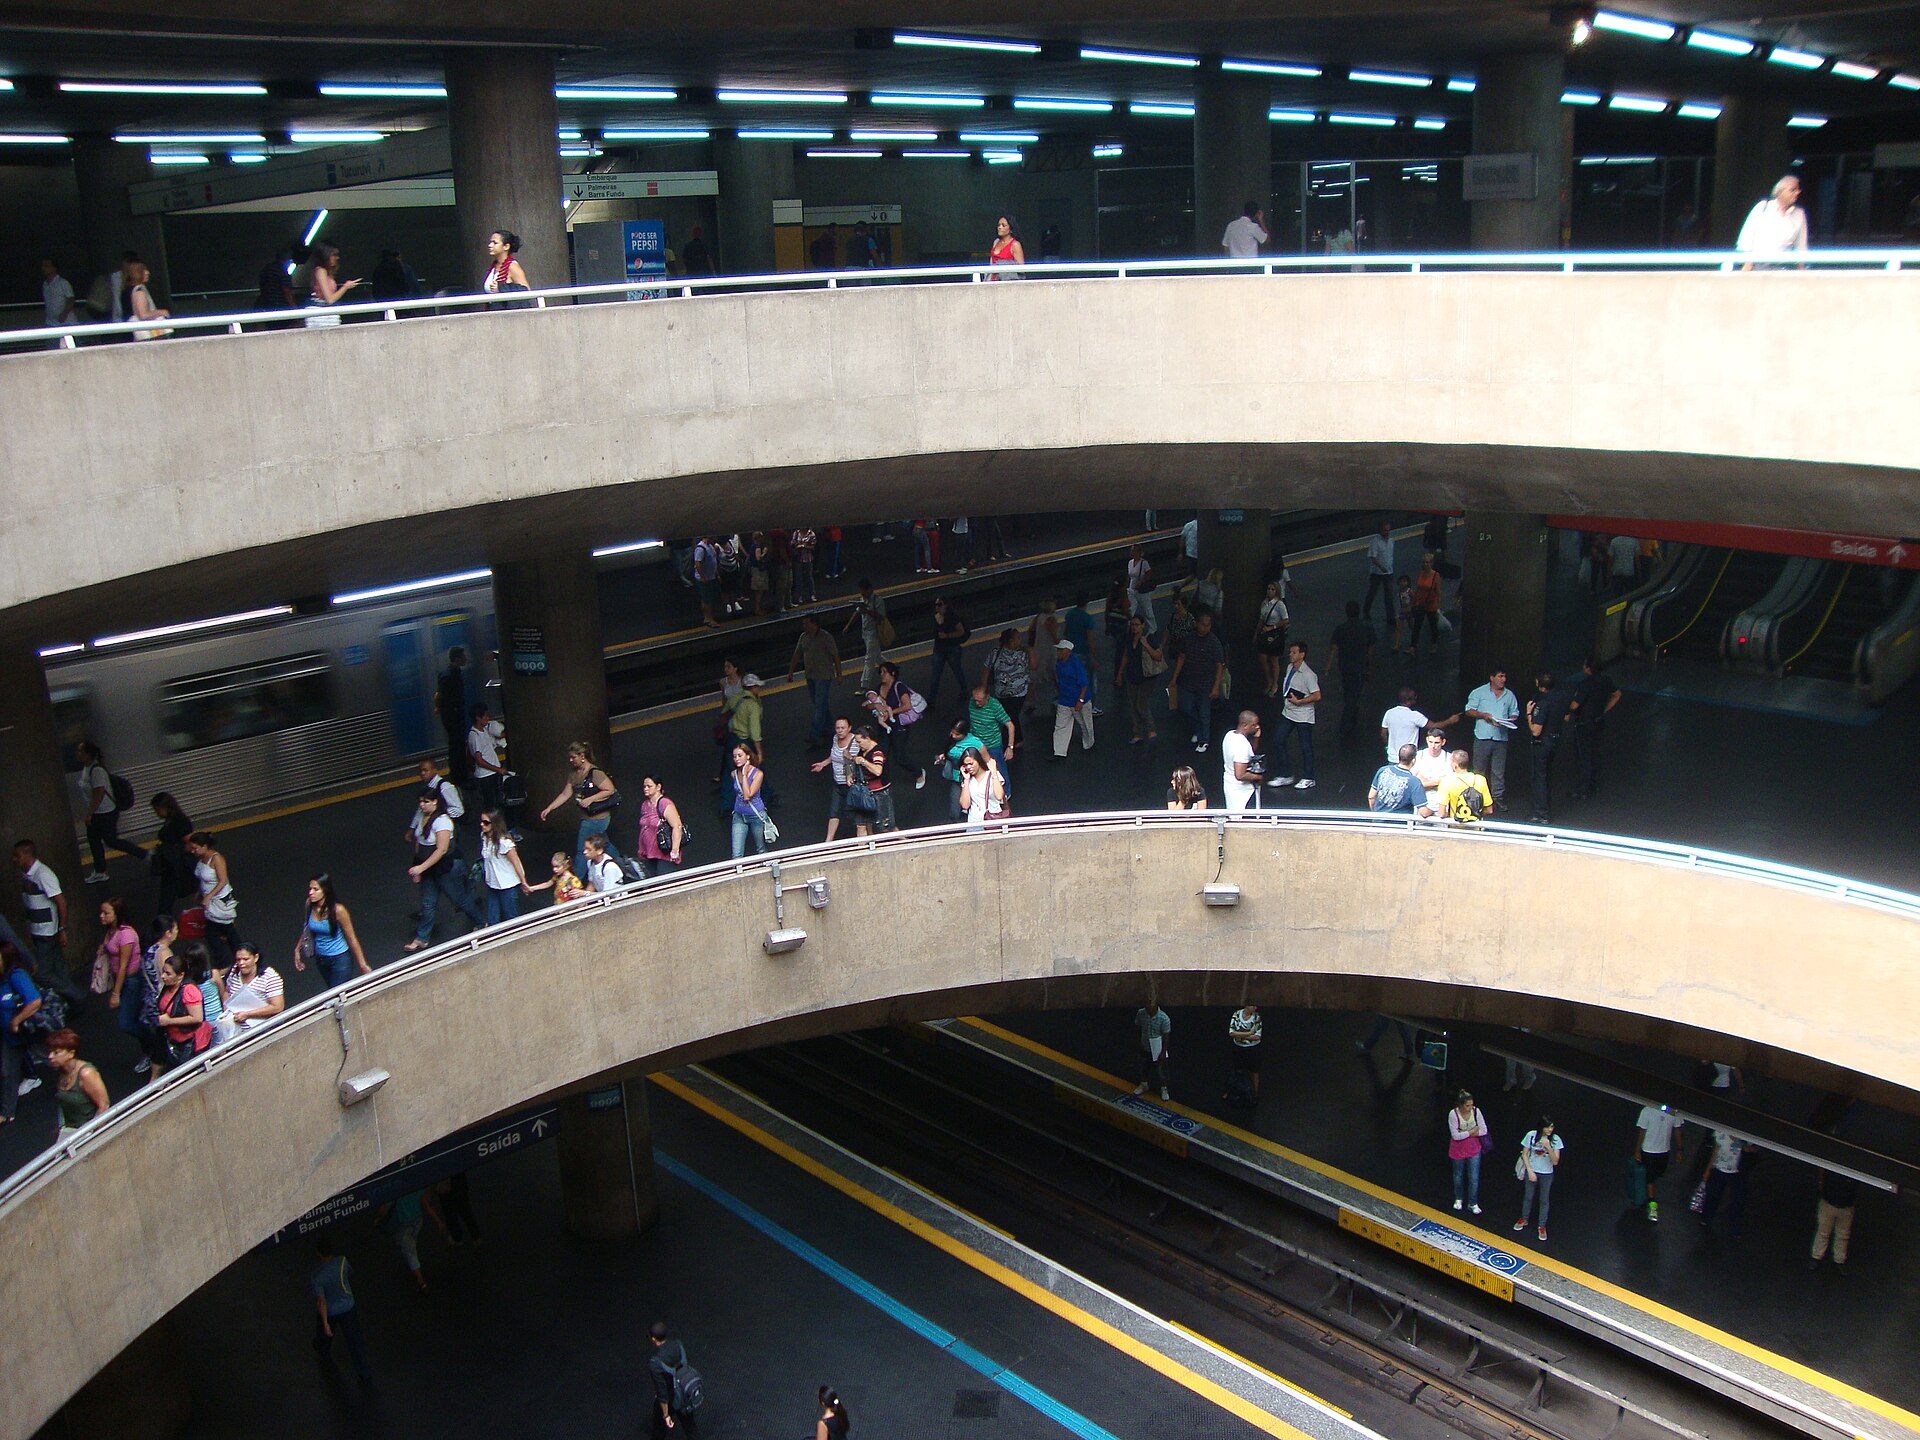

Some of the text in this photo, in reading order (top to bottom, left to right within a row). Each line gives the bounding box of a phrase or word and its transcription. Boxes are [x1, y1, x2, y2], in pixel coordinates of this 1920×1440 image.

[586, 174, 618, 182] Embarque
[606, 190, 625, 198] Funda
[631, 240, 658, 251] PEPSI?
[1830, 540, 1878, 558] Saída
[477, 1131, 521, 1158] Saída
[298, 1198, 370, 1234] Barra Funda
